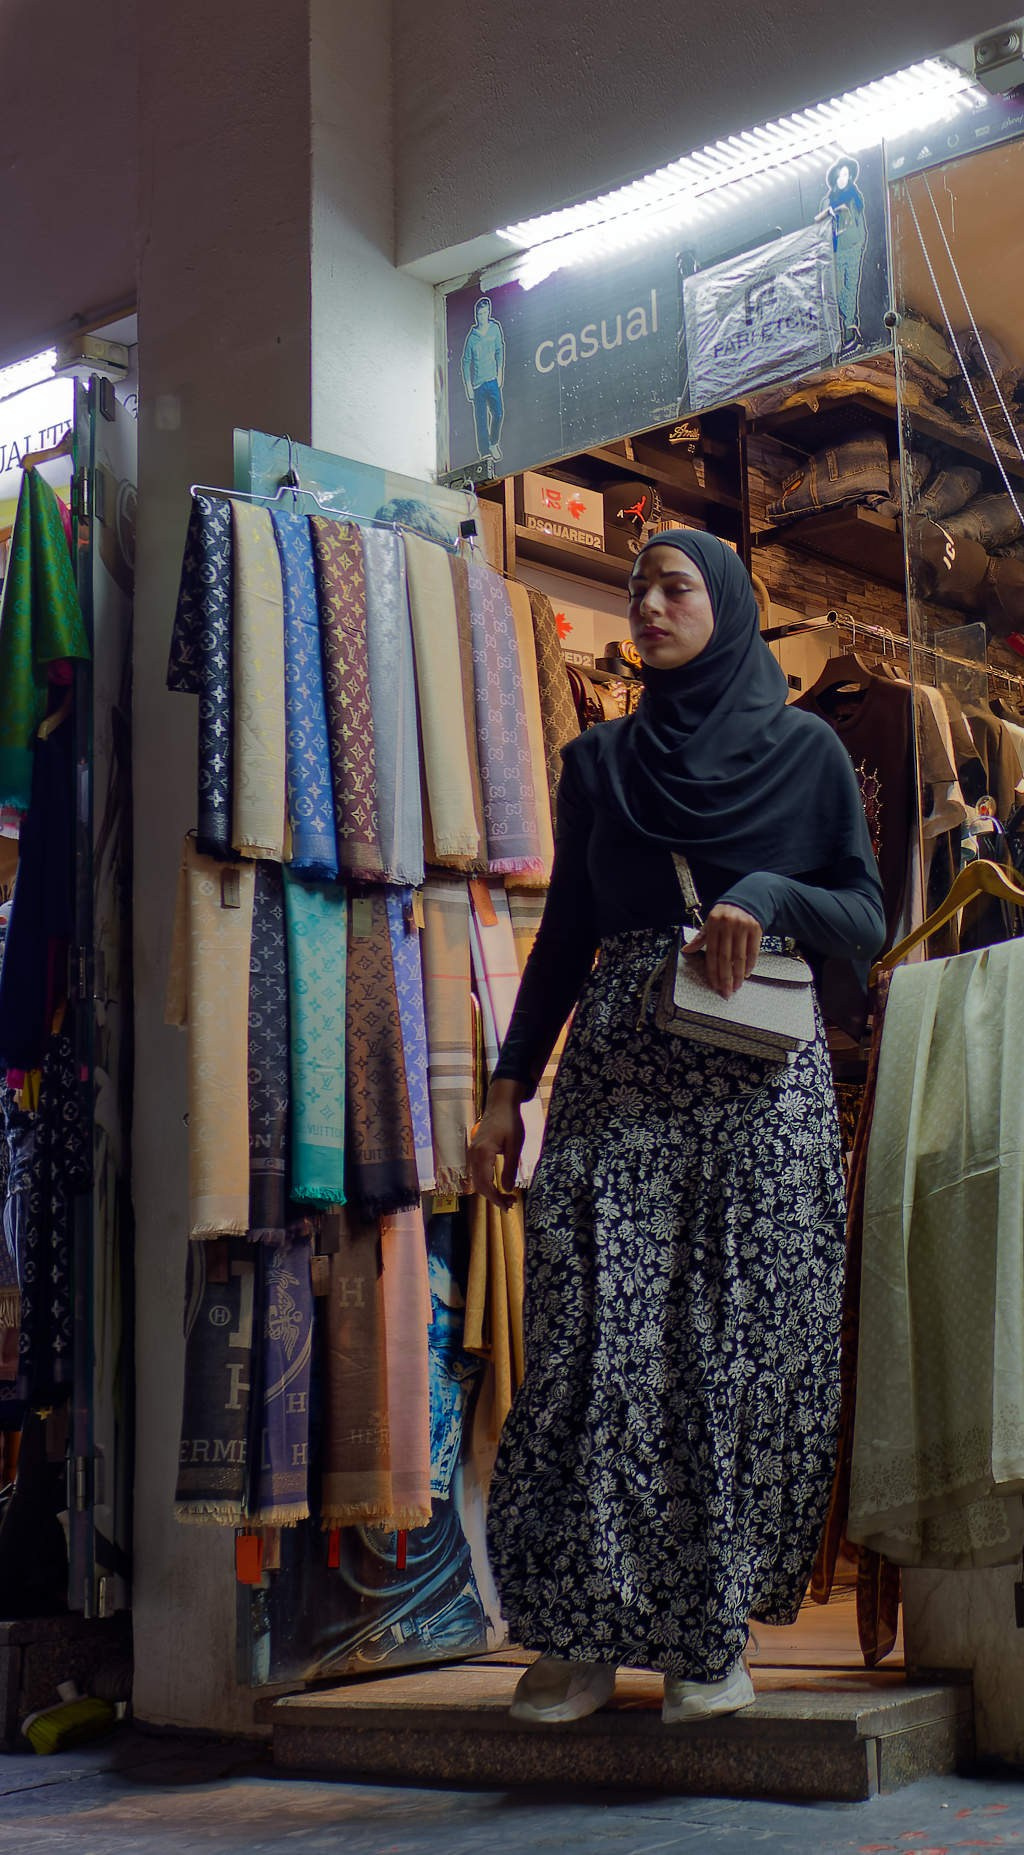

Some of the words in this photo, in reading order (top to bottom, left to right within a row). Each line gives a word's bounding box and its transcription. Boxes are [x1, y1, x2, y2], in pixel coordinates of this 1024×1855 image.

[535, 288, 658, 374] casual
[526, 515, 602, 549] DSQUARED2
[286, 1392, 306, 1413] H
